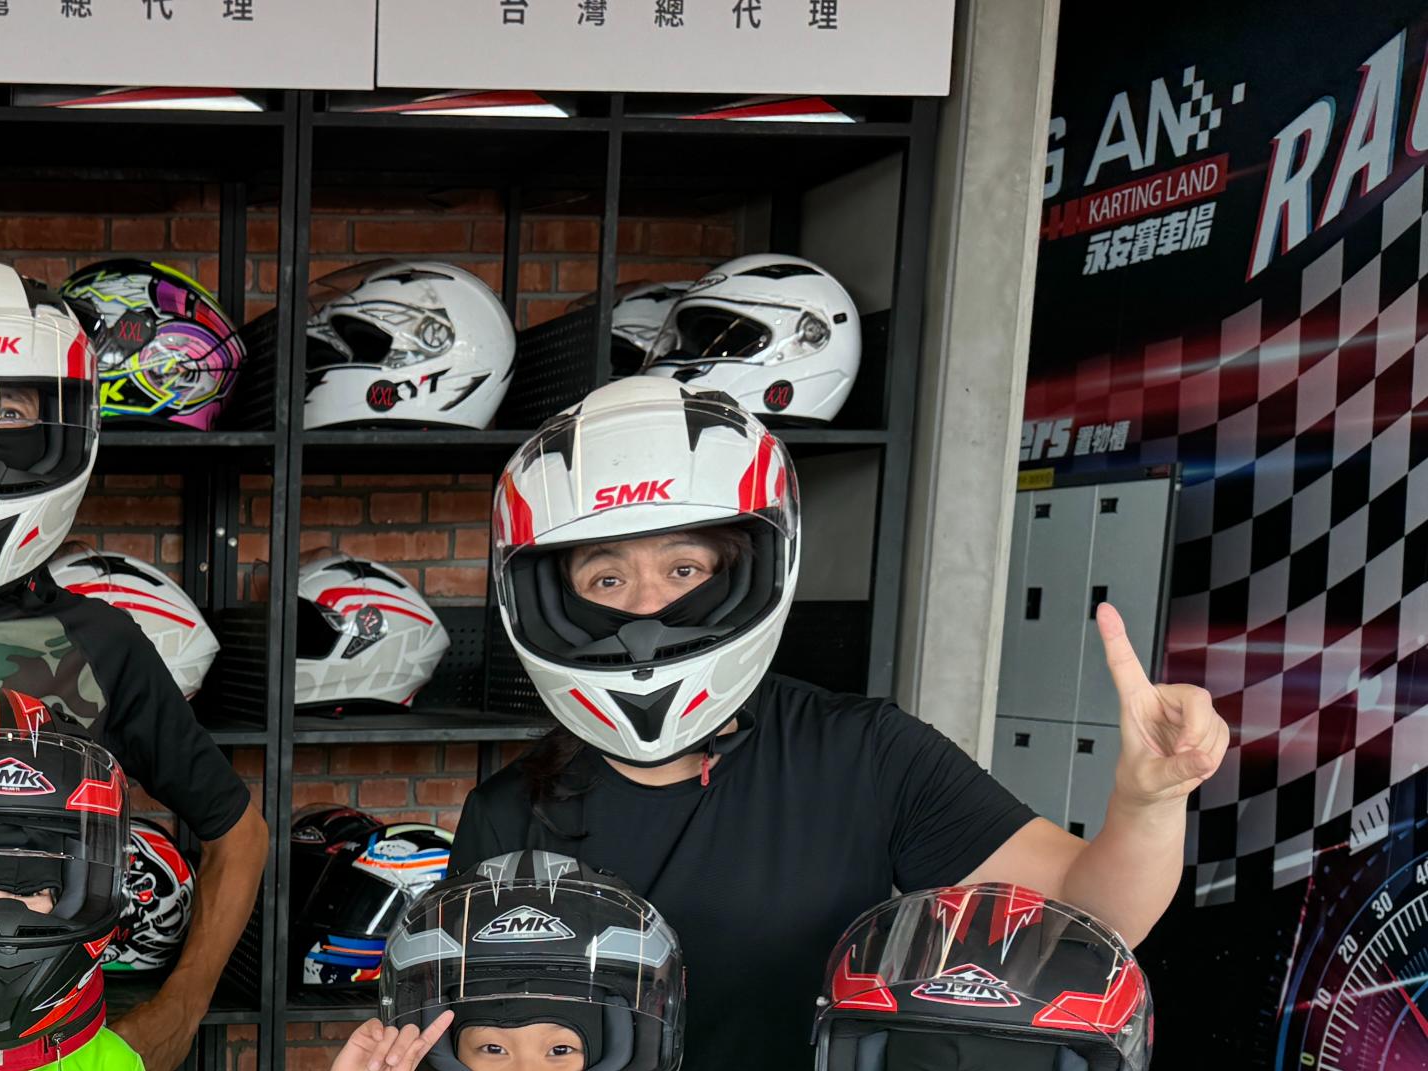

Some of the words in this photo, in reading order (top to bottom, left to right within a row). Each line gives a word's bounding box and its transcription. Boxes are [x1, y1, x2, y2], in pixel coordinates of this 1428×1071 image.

[1245, 27, 1428, 283] RA
[1088, 180, 1163, 225] KARTING
[1166, 163, 1219, 202] LAND
[1082, 202, 1217, 275] 永安賽車場
[118, 320, 144, 342] XXL
[369, 385, 394, 407] XXL
[765, 386, 790, 407] XXL
[593, 478, 676, 511] SMK
[1372, 891, 1394, 920] 30
[486, 916, 559, 937] SMK
[1338, 934, 1359, 965] 20
[1312, 987, 1332, 1011] 10
[1300, 1052, 1315, 1066] 0
